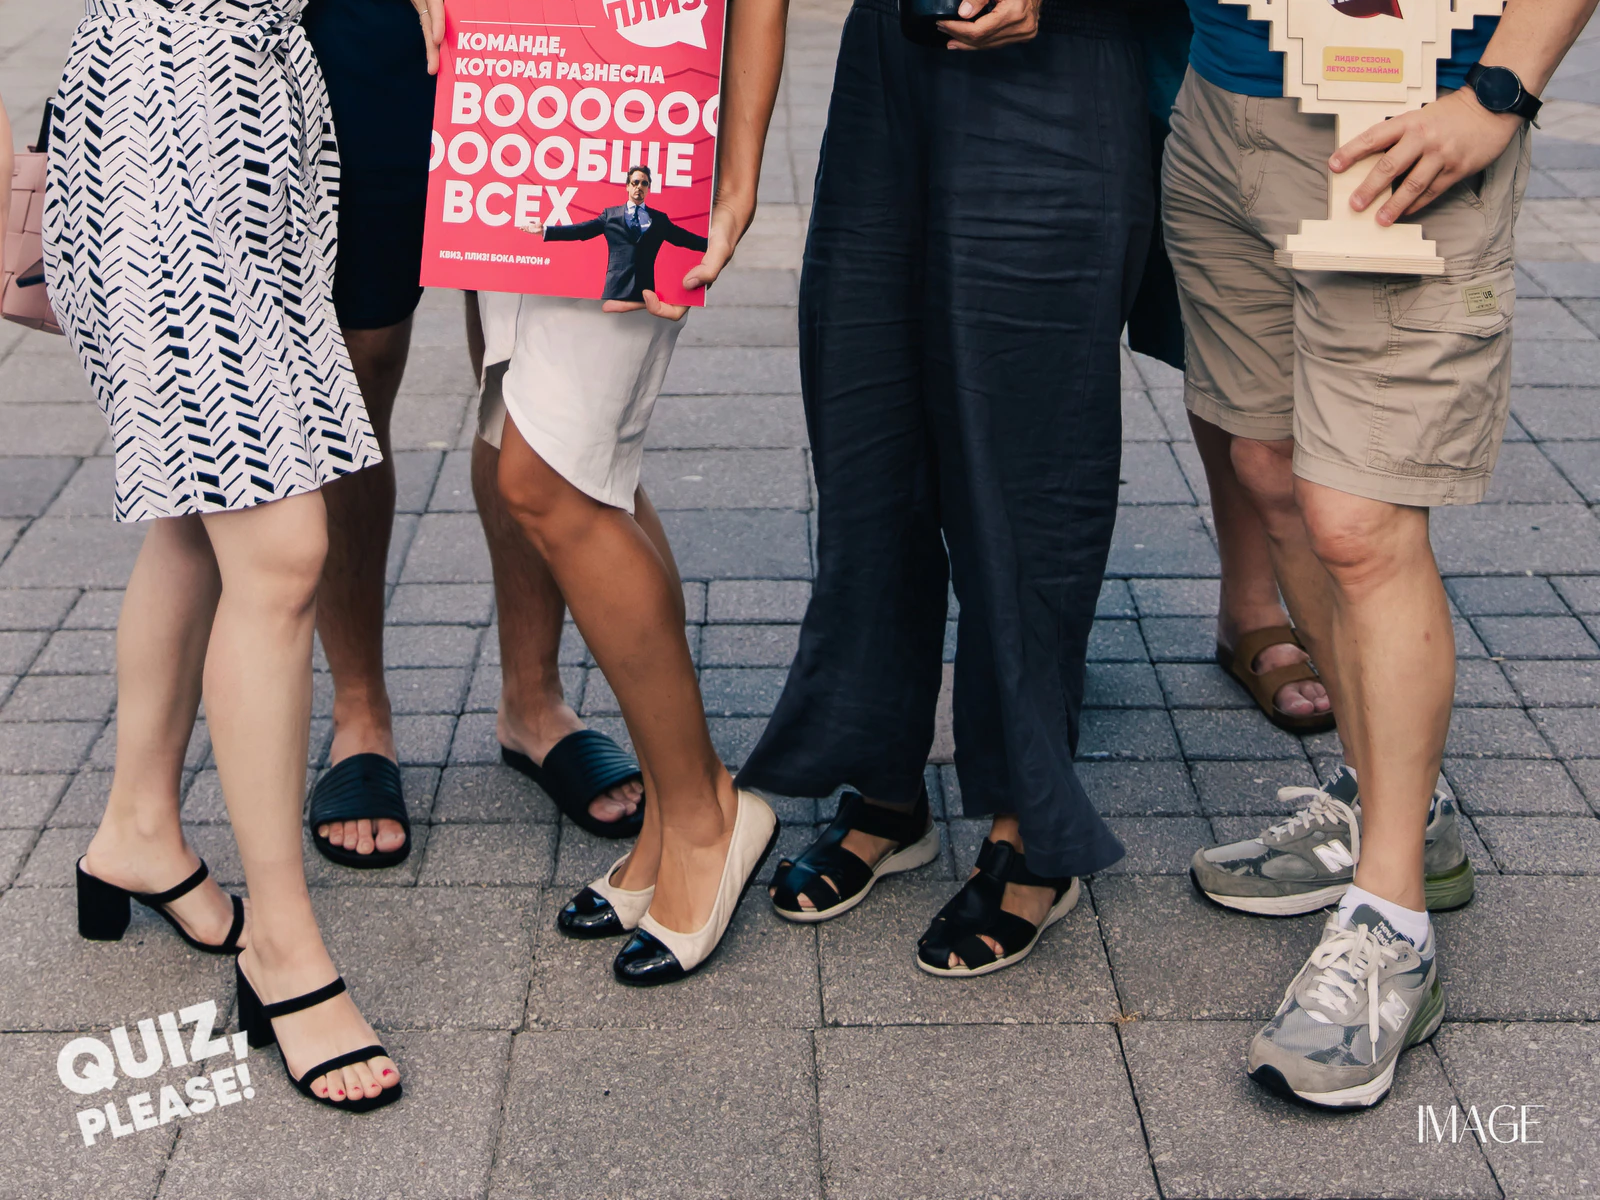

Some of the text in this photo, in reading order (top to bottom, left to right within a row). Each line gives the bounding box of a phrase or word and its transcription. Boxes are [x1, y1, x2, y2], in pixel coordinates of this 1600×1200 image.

[457, 32, 566, 58] КОМАНДЕ,
[1334, 55, 1359, 63] ЛИДЕР
[455, 57, 665, 85] КОТОРАЯ РАЗНЕСЛА
[1326, 65, 1346, 73] ЛЕТО
[1366, 66, 1400, 74] МАЙАМИ
[442, 179, 578, 228] ВСЕХ
[439, 250, 463, 261] КВИЗ,
[465, 251, 489, 262] ПЛИЗ!
[490, 253, 515, 263] БОКА
[516, 255, 543, 265] РАТОН
[1378, 921, 1392, 938] new
